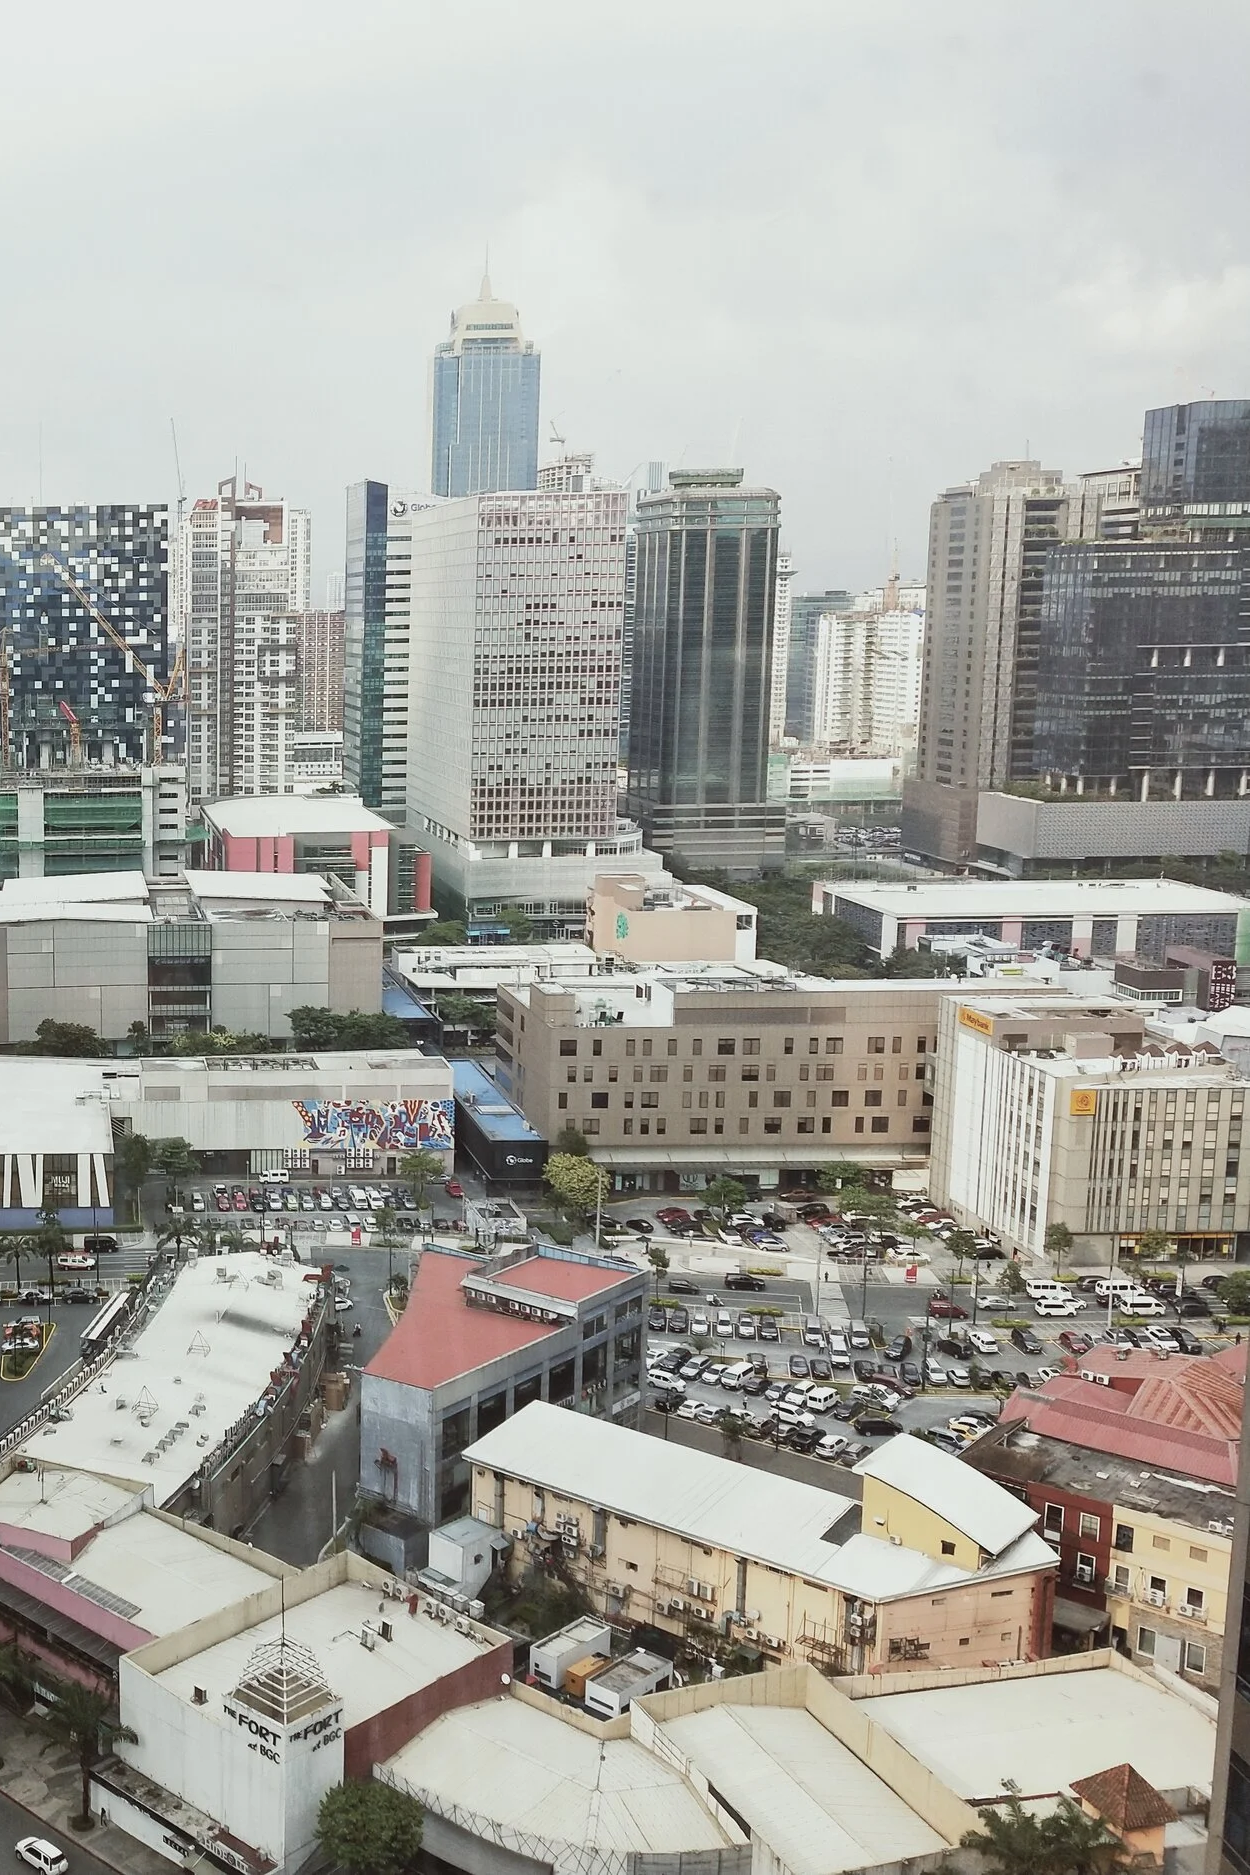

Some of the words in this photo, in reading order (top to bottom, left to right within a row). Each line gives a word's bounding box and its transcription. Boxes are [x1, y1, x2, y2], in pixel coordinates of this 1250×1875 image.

[411, 503, 437, 511] Glob
[966, 1013, 989, 1031] Maybank
[223, 1704, 237, 1720] THE
[238, 1713, 282, 1746] FORT
[289, 1730, 303, 1743] THE
[303, 1708, 344, 1740] FORT
[312, 1740, 321, 1752] at
[323, 1727, 343, 1746] BGC
[248, 1742, 258, 1751] at
[259, 1744, 281, 1765] BGC
